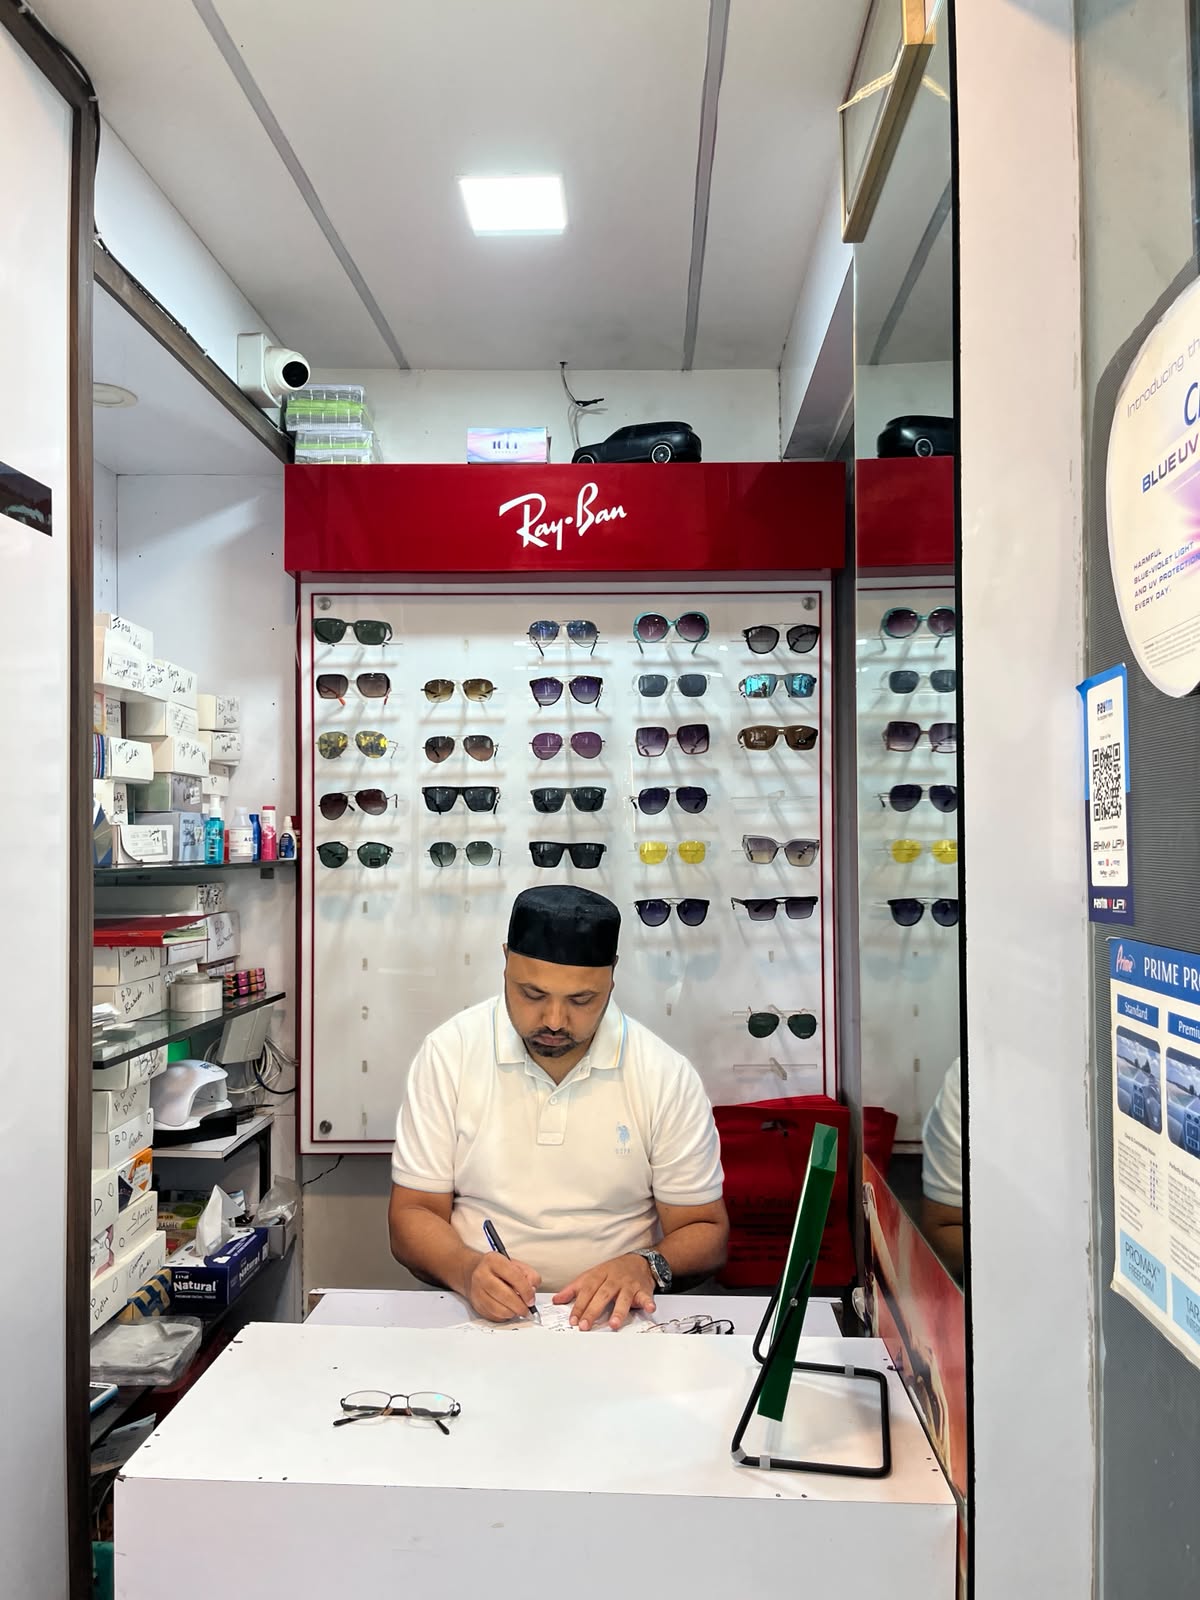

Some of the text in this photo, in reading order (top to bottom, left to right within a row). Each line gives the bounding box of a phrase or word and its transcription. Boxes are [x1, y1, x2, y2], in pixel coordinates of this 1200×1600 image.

[1127, 353, 1184, 418] Introducing
[1142, 453, 1177, 493] BLUE
[1134, 548, 1161, 570] HARMFUL
[1134, 541, 1194, 584] BLUE-VIOLET LIGHT
[1135, 585, 1147, 598] AND
[1135, 595, 1154, 611] EVERY
[1144, 956, 1200, 992] PRIME PR
[1124, 1002, 1149, 1021] Standard
[173, 1281, 217, 1292] Natural
